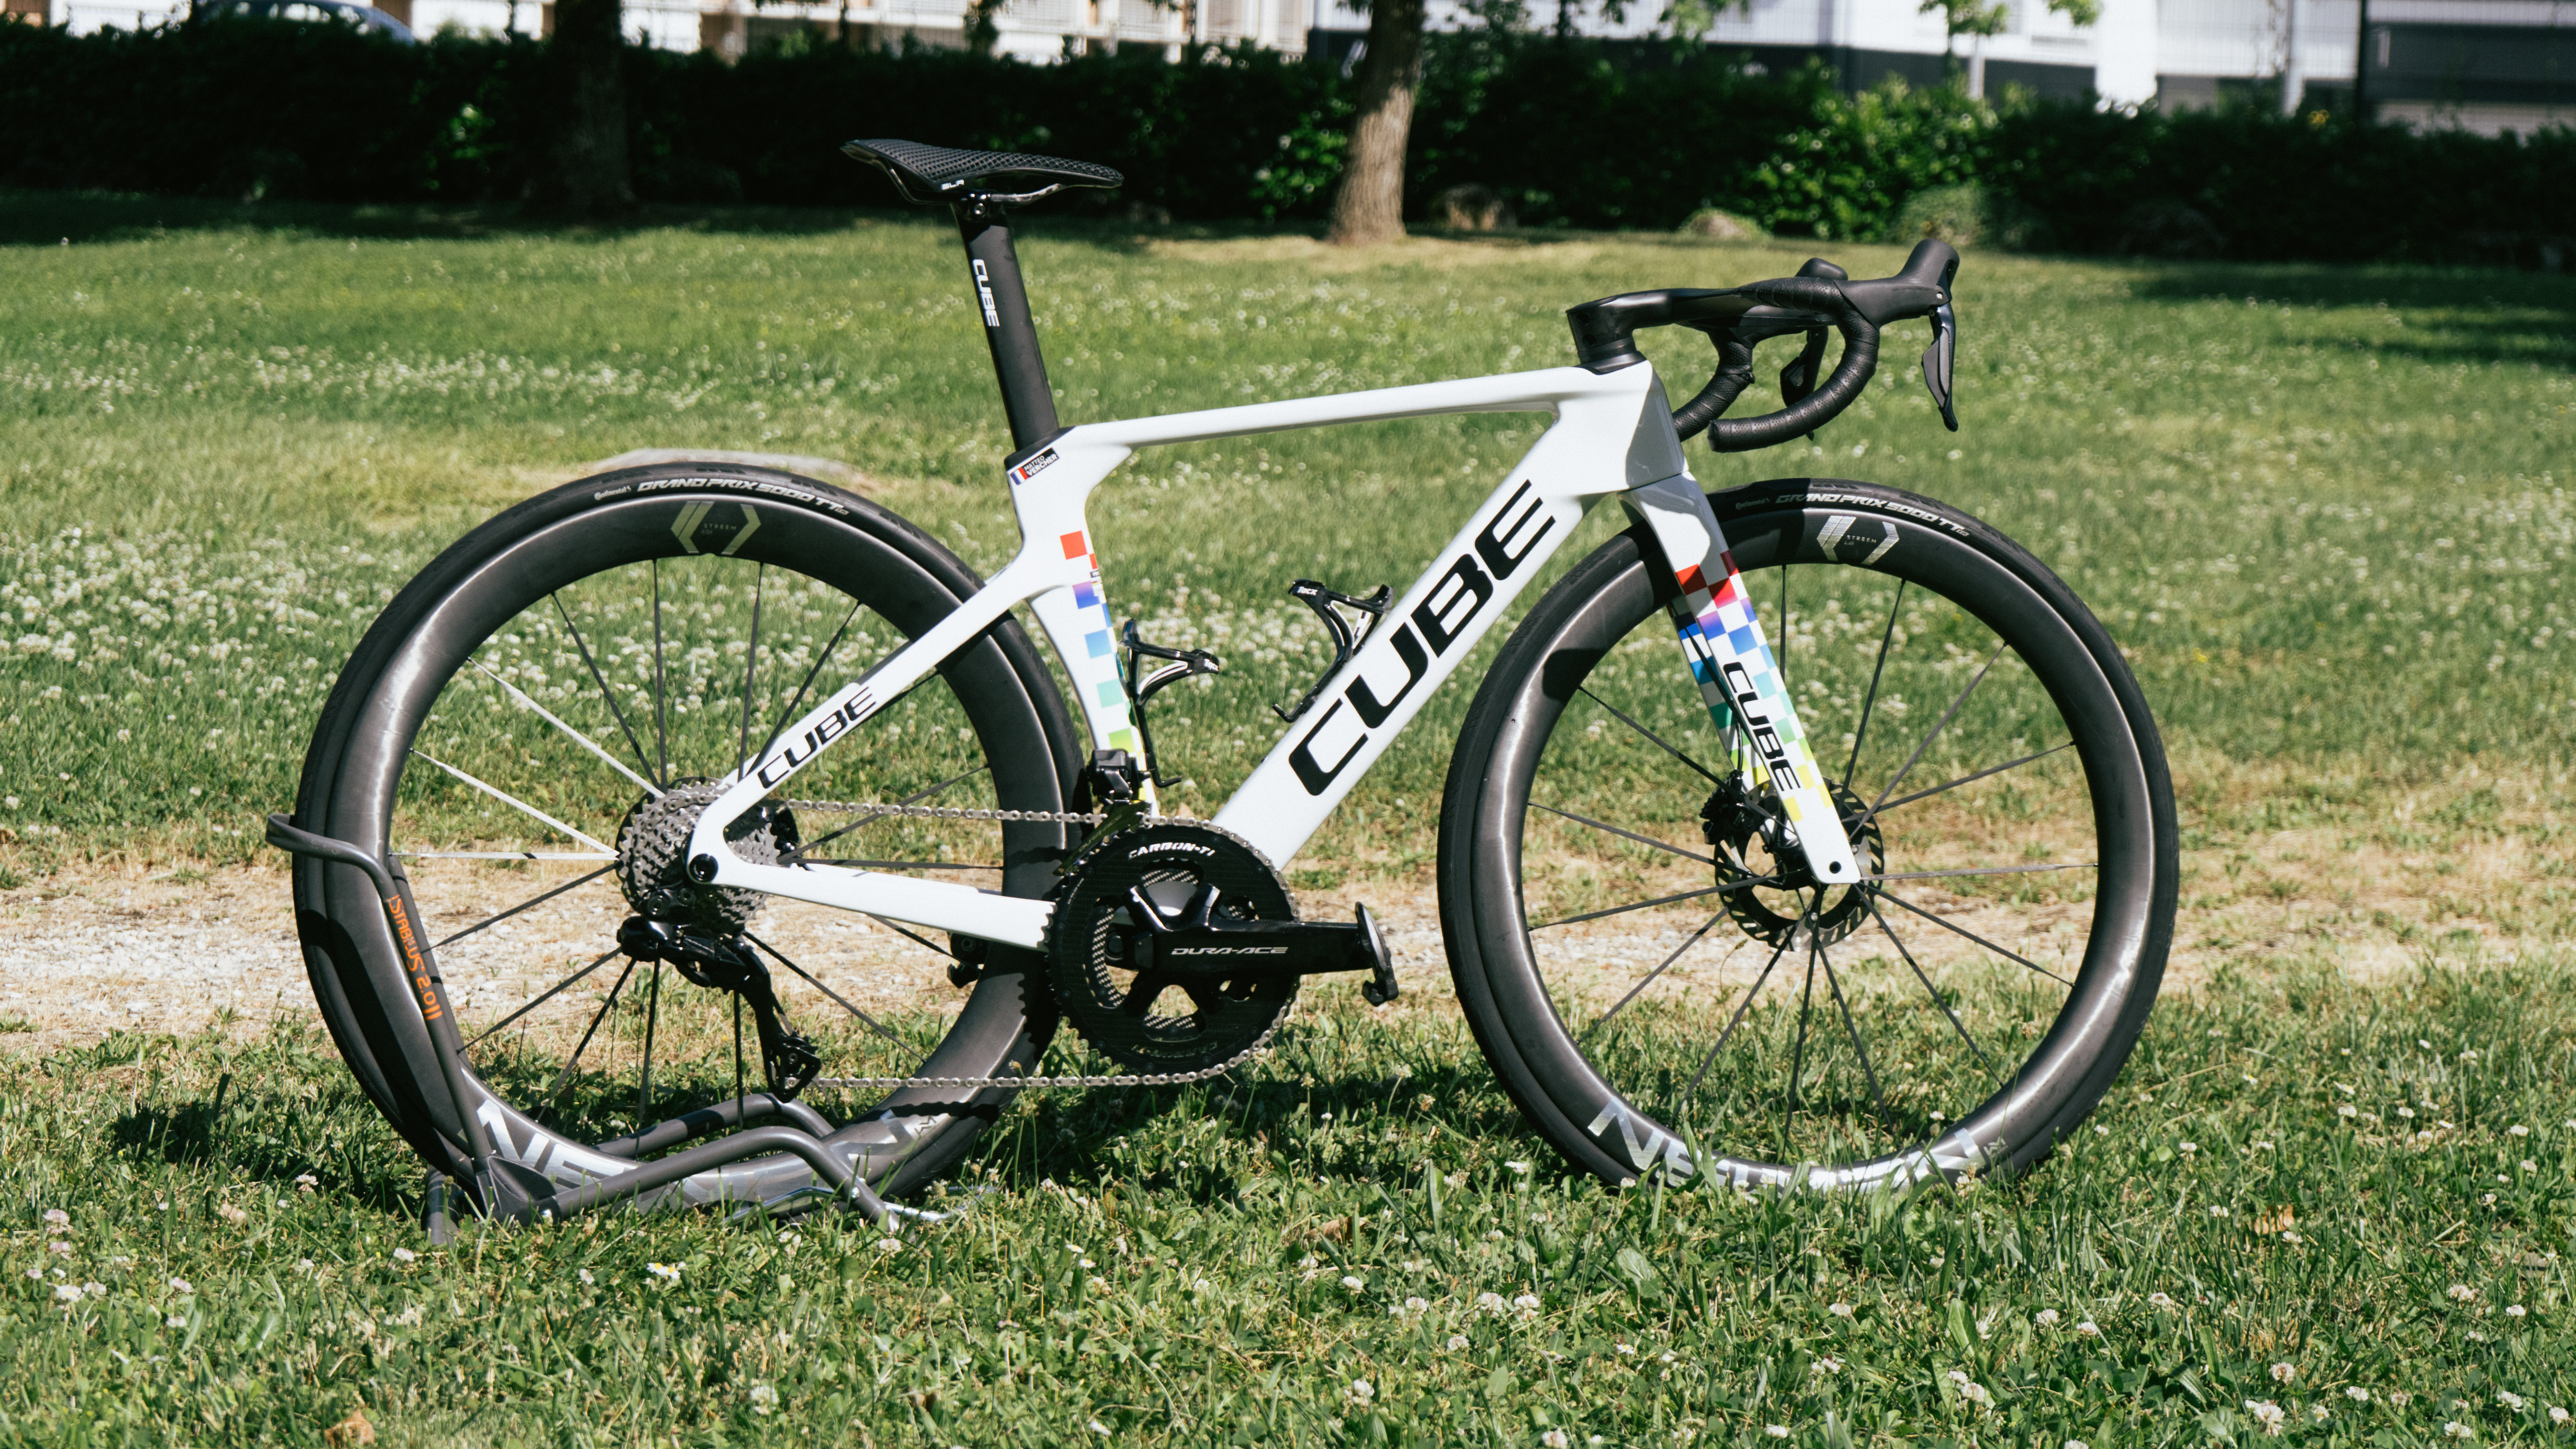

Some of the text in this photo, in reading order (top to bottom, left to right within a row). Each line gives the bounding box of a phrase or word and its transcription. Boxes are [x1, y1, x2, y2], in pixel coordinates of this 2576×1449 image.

[972, 259, 1000, 327] CUBE
[1024, 455, 1045, 471] MATTEO
[1027, 453, 1057, 476] VERCHER
[594, 486, 627, 500] Continental
[637, 478, 709, 492] GRAND
[705, 478, 756, 491] PRIX
[755, 483, 816, 503] 5000
[813, 495, 845, 512] TT
[1736, 498, 1766, 510] Continental
[1775, 493, 1841, 504] GRAND
[1838, 494, 1886, 508] PRIX
[1886, 501, 1938, 523] 5000
[1935, 516, 1965, 536] TT
[1297, 586, 1318, 596] Tacx
[1289, 479, 1556, 796] CUBE
[1204, 658, 1219, 671] Tacx
[757, 686, 877, 789] CUBE
[1723, 661, 1801, 792] CUBE
[1128, 842, 1216, 859] CARBON-TI
[1171, 947, 1288, 956] DURA-ACE
